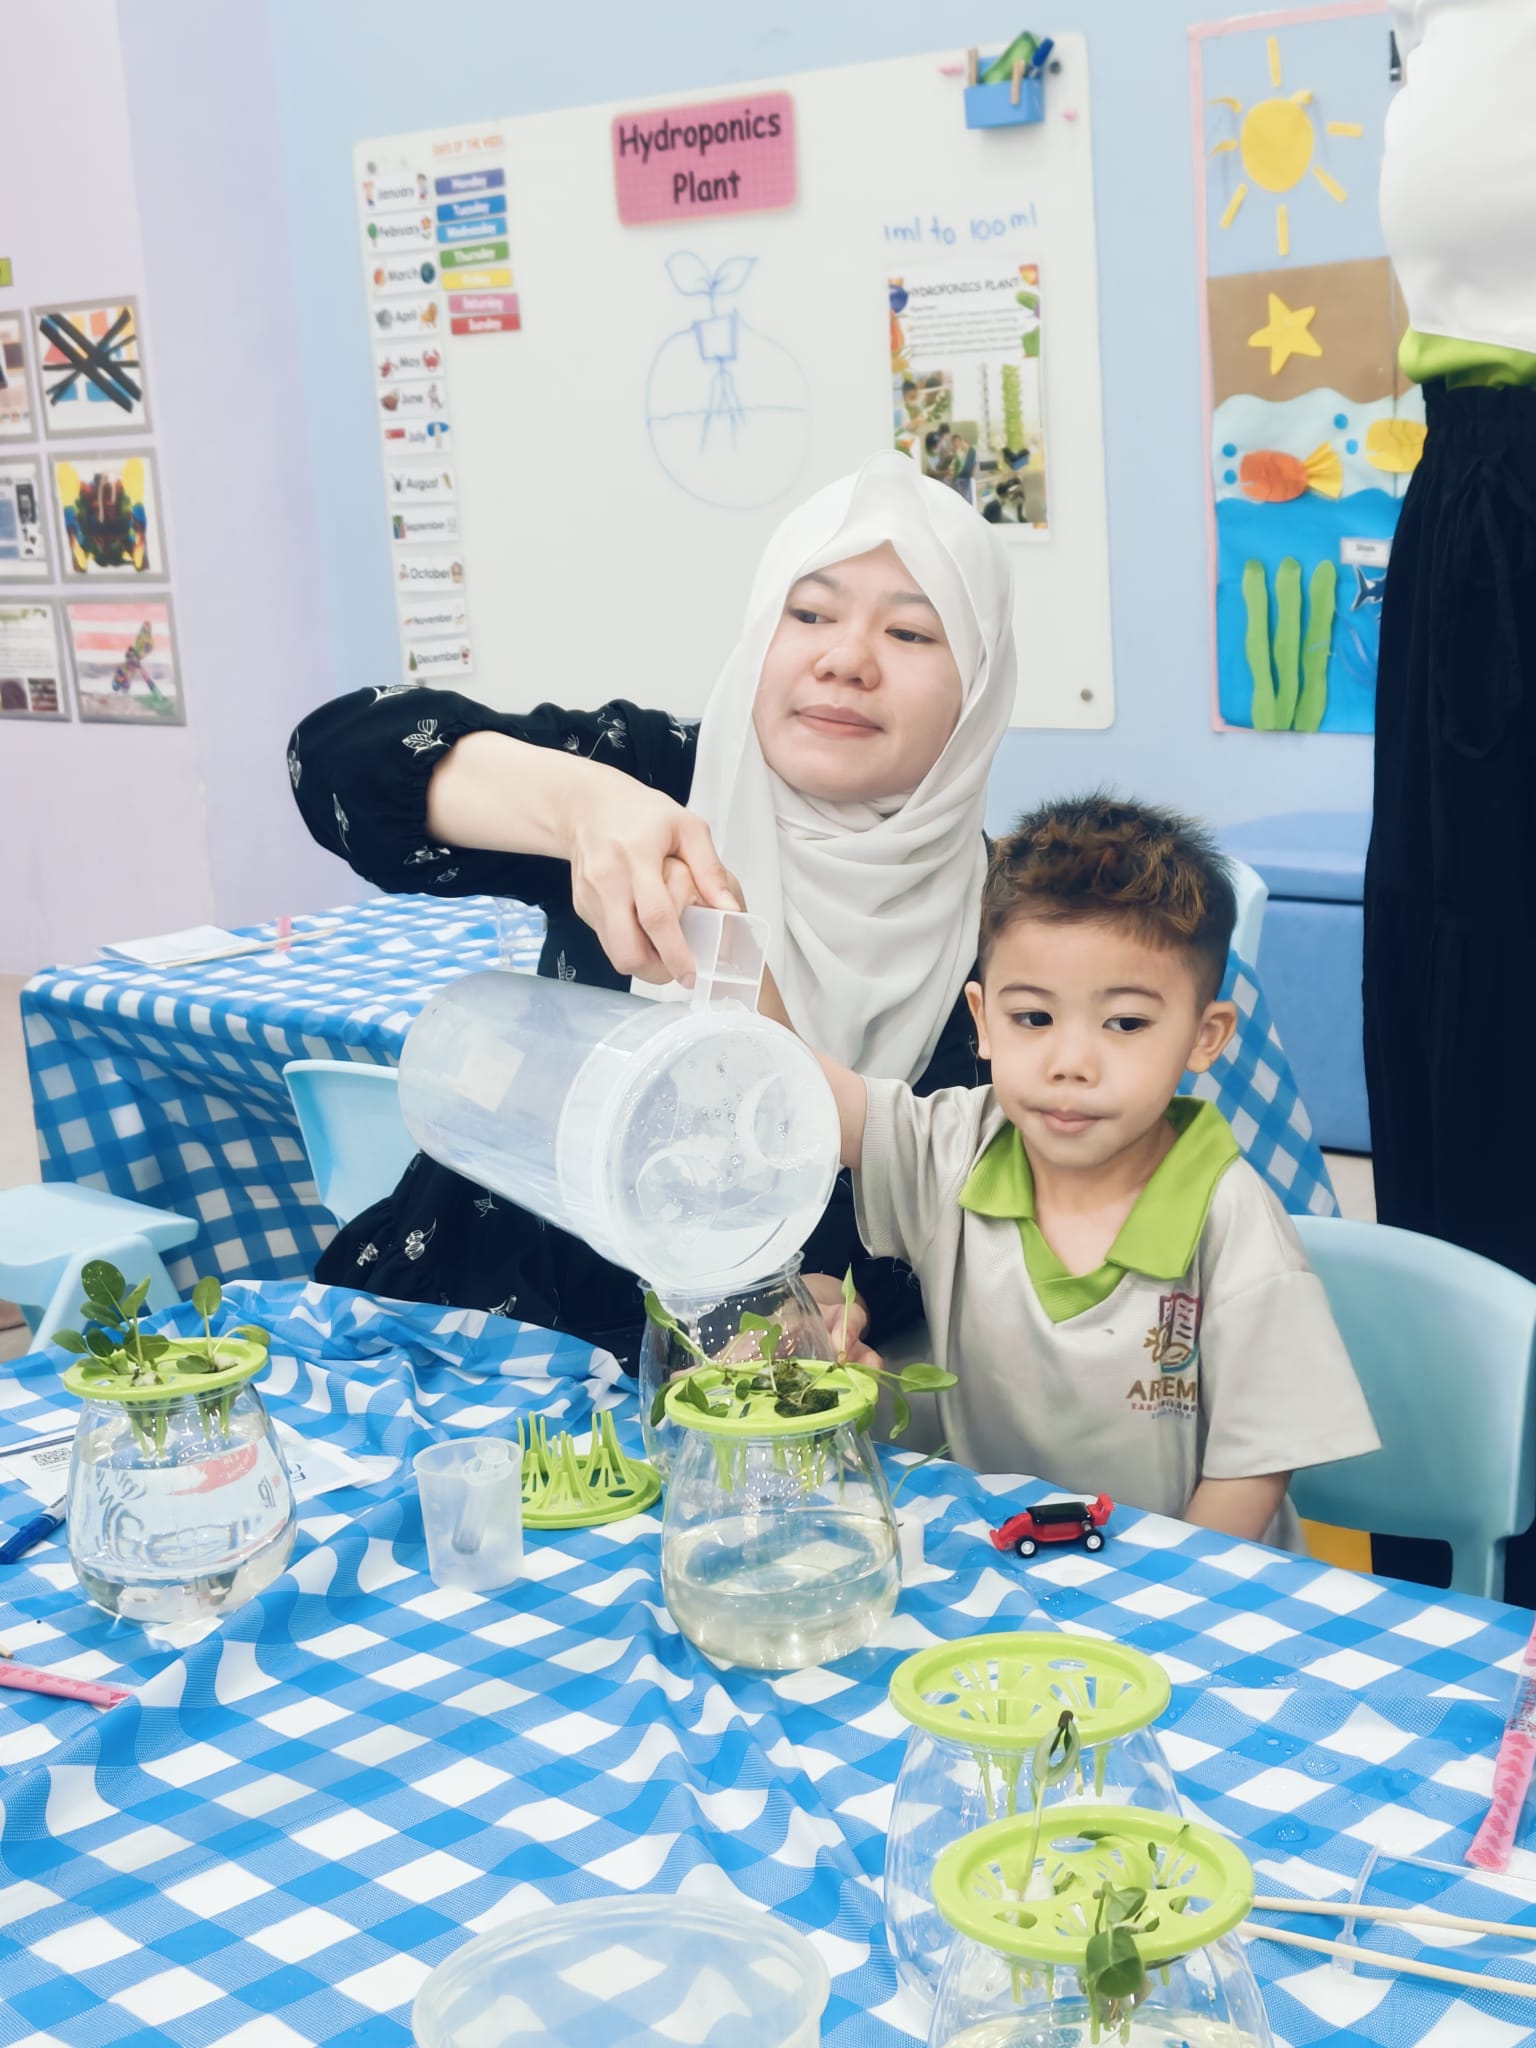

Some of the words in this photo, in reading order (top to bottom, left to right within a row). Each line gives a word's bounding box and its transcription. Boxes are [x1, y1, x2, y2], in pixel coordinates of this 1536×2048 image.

[618, 108, 782, 165] Hydroponics
[672, 169, 741, 204] Plant
[883, 215, 921, 241] 1ml
[929, 214, 957, 245] to
[985, 277, 1019, 291] PLANT
[406, 477, 439, 491] August
[410, 567, 450, 579] October
